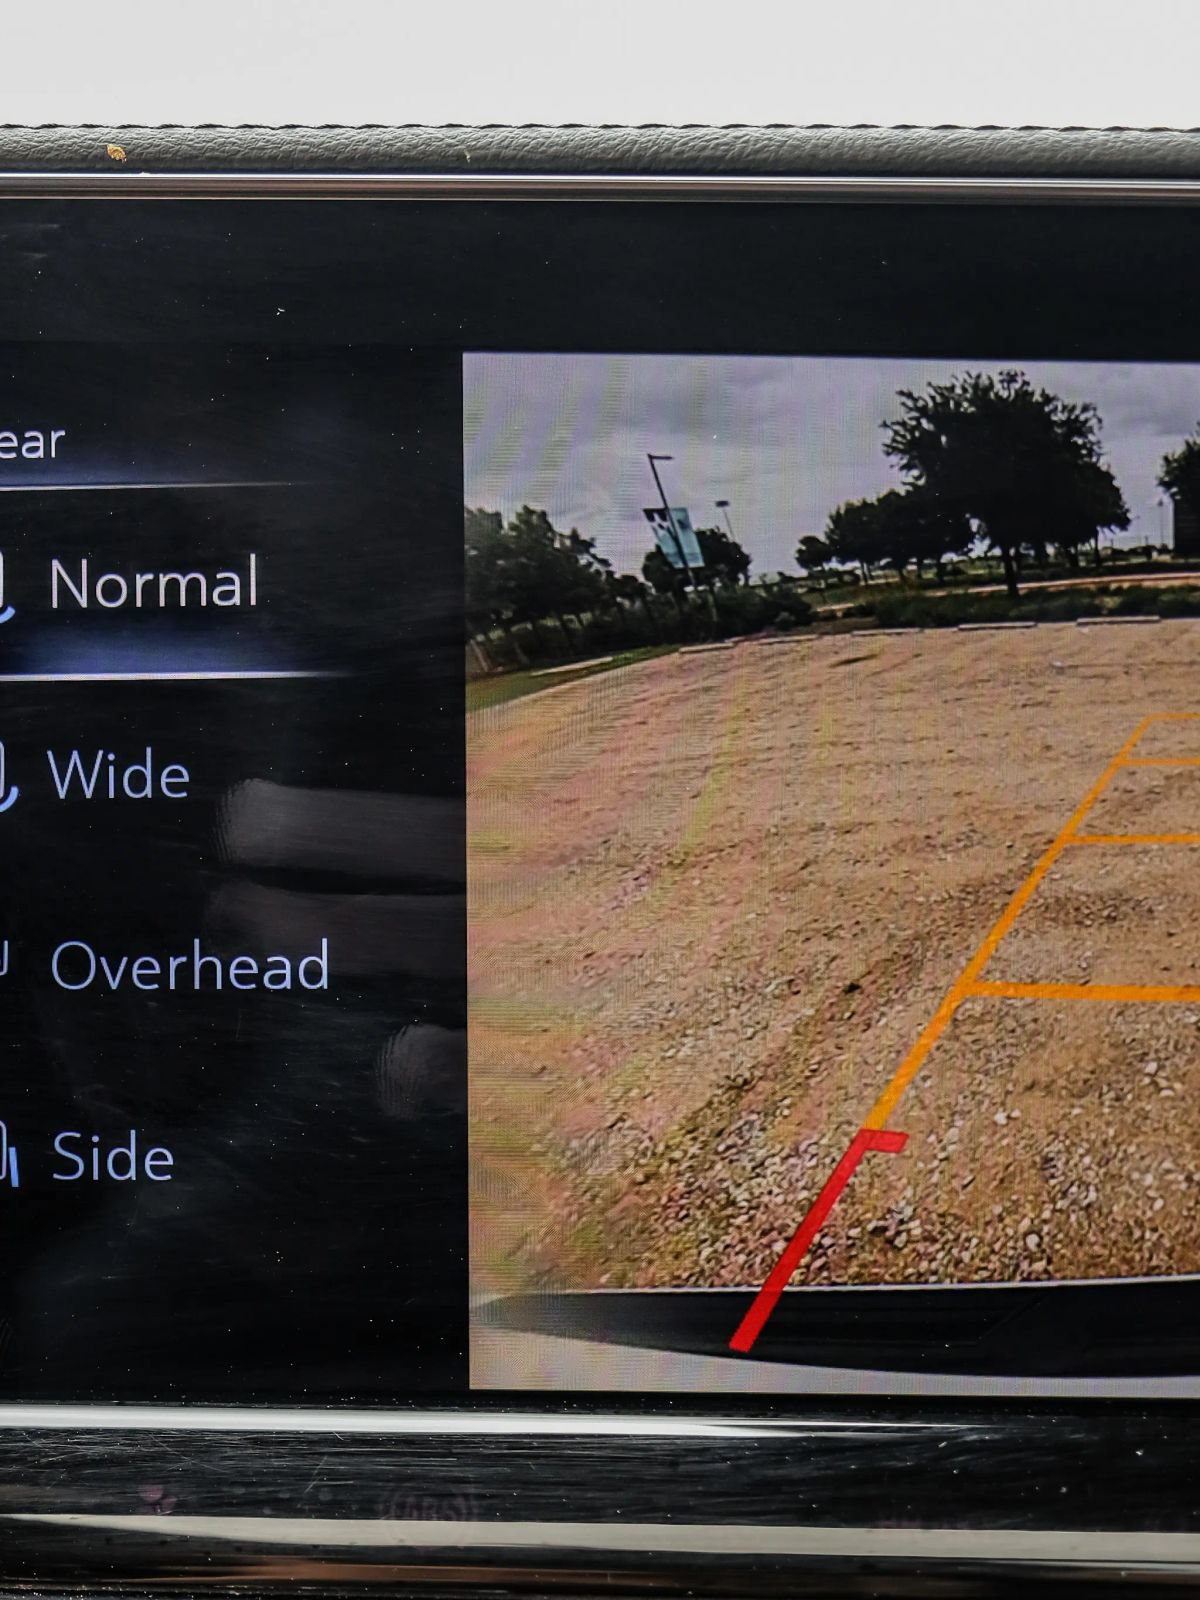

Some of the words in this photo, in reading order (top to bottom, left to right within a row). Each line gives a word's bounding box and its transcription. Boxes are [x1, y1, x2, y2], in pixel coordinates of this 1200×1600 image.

[51, 552, 258, 608] Normal
[46, 746, 191, 800] Wide
[51, 937, 329, 991] Overhead
[52, 1129, 175, 1181] Side
